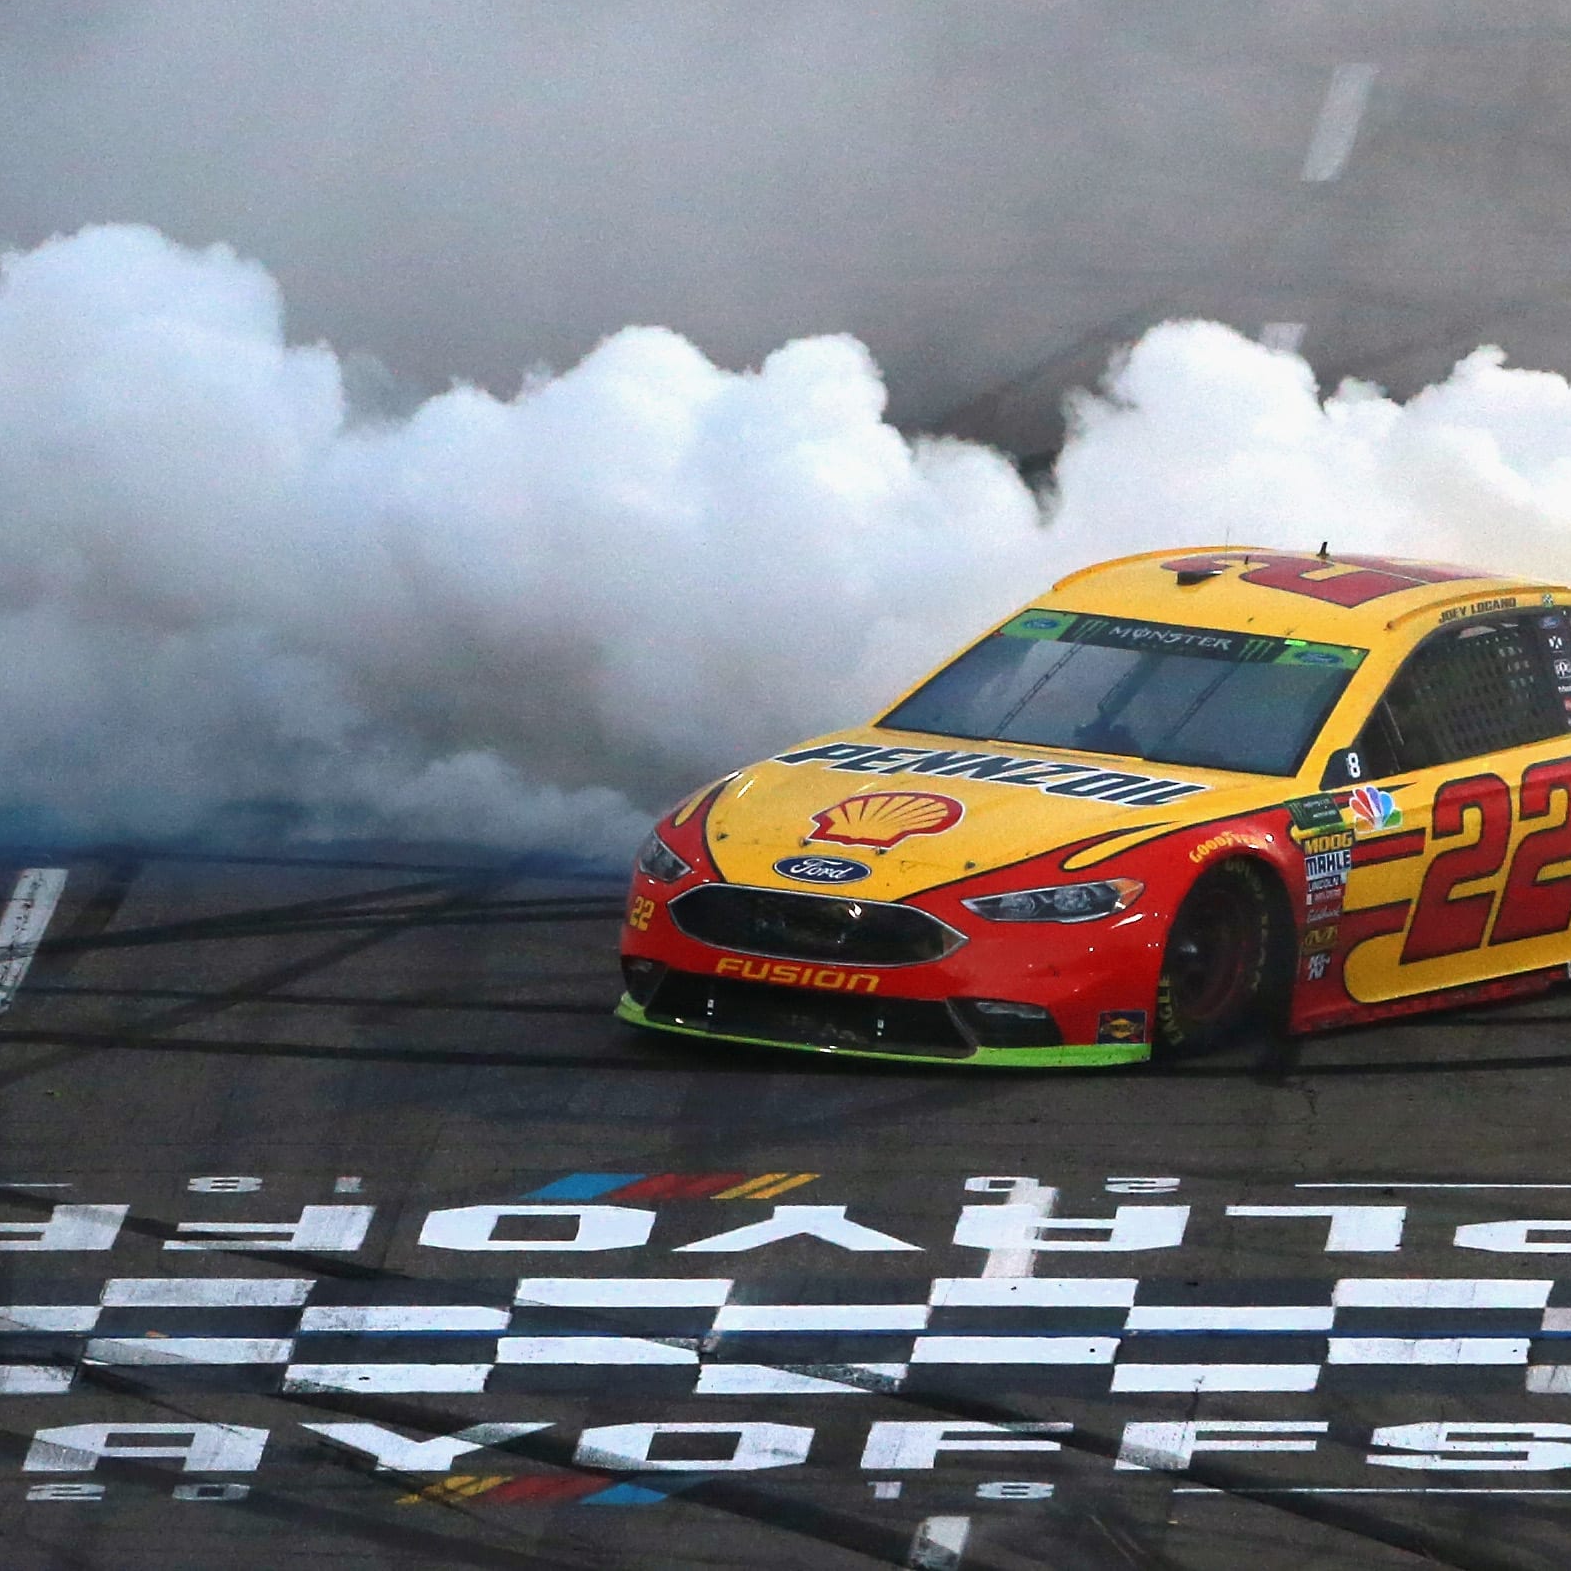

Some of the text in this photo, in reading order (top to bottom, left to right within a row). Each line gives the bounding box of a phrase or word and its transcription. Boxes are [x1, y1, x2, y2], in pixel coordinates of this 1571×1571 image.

[773, 741, 1212, 807] PENNZOIL
[1304, 831, 1353, 855] MOOG
[786, 857, 851, 881] Ford
[1305, 850, 1351, 877] MAHLE
[630, 895, 655, 931] 22
[715, 958, 880, 992] FUSION
